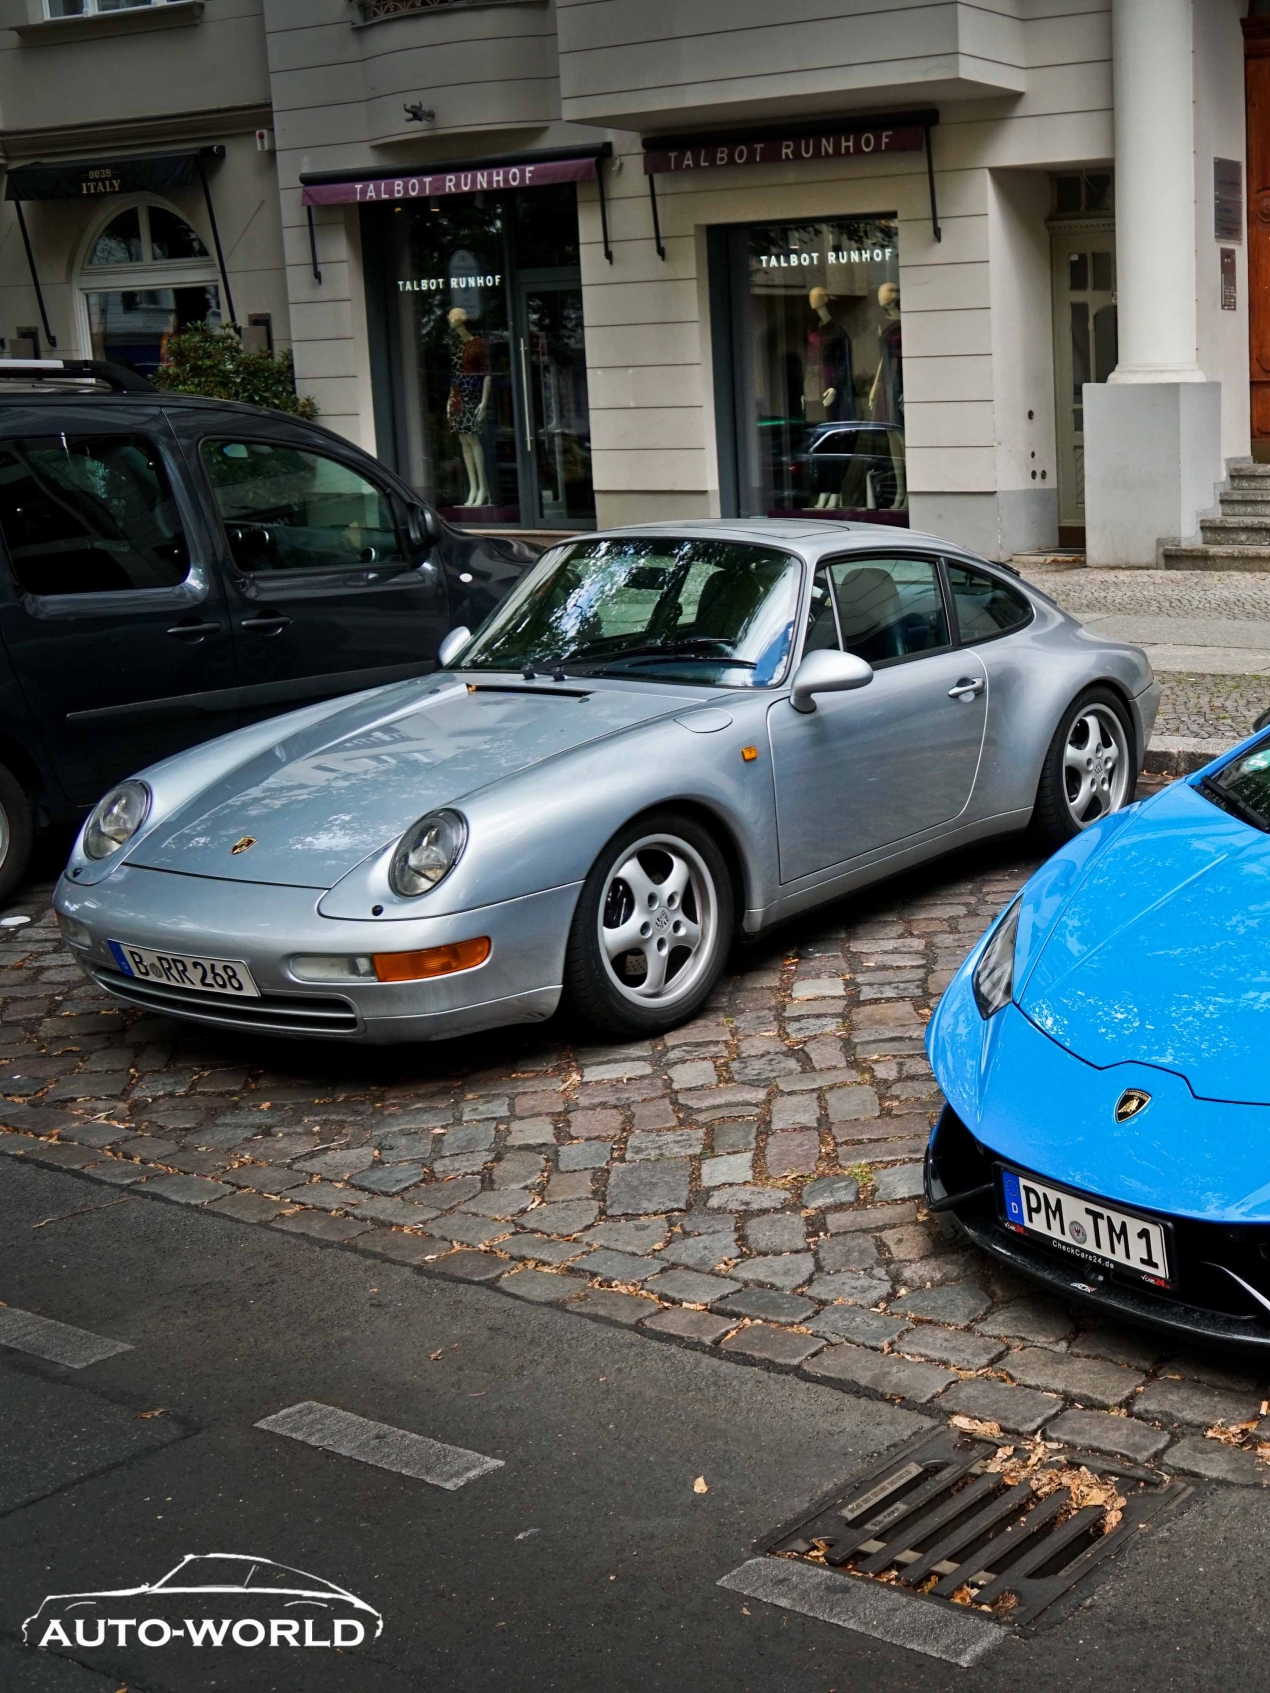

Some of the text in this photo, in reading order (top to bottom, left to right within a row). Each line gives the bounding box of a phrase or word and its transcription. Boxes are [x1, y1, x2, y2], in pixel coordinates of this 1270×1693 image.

[668, 131, 893, 170] TALBOT RUNHOF
[81, 179, 121, 195] ITALY
[355, 166, 535, 201] TALBOT RUNHOF
[760, 249, 892, 268] TALBOT RUNHOF
[398, 275, 501, 292] TALBOT RUNHOF
[128, 949, 150, 977] B
[1011, 1202, 1019, 1214] D
[1022, 1184, 1066, 1236] PM
[1052, 1240, 1114, 1269] CheckCars24.de
